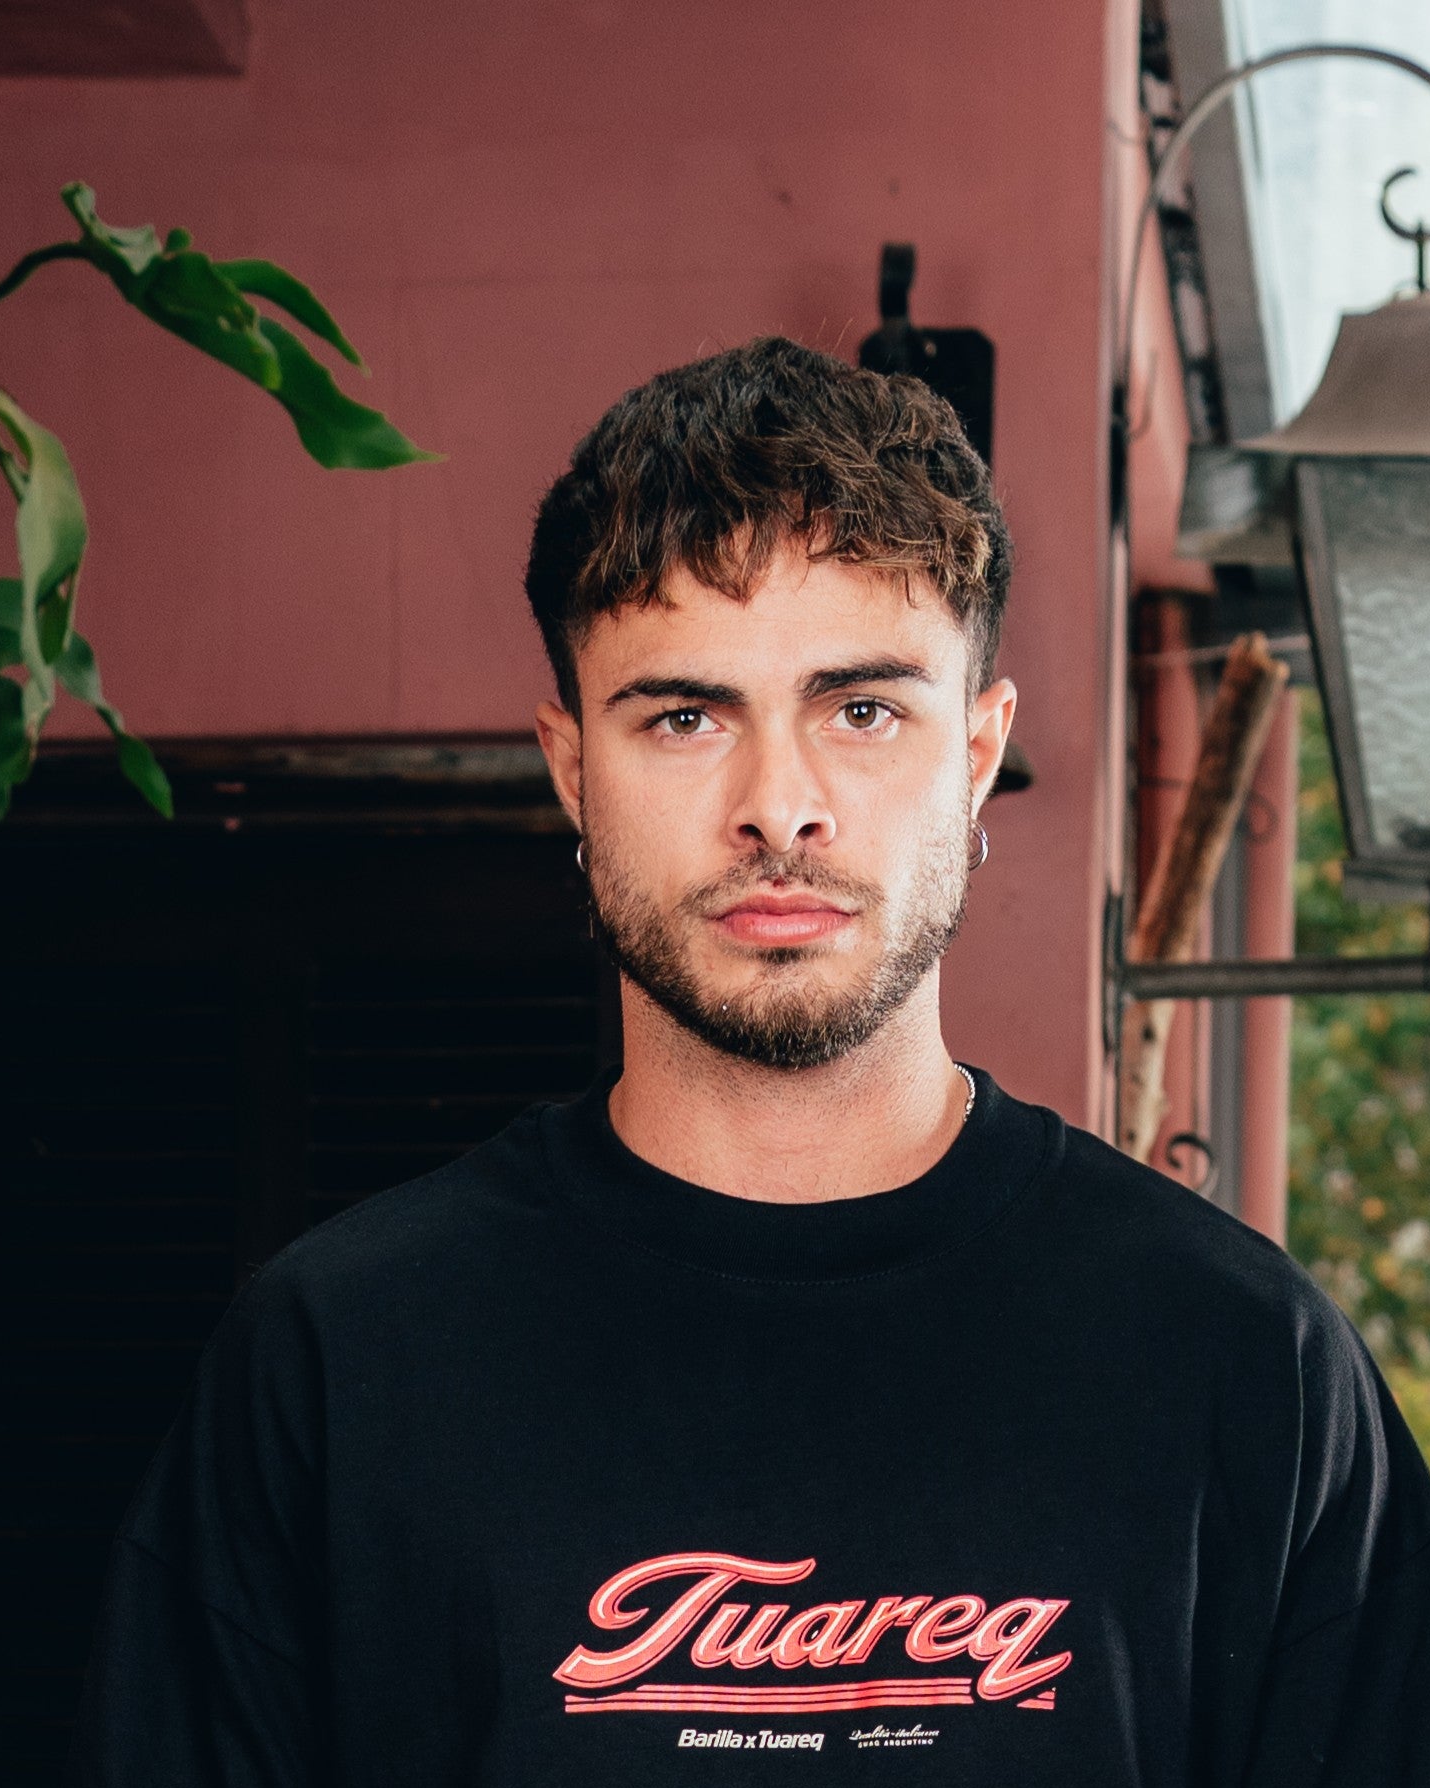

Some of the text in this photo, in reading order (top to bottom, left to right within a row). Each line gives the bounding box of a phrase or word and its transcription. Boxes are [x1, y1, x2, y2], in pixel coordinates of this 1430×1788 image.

[553, 1552, 1072, 1701] Tuareq
[678, 1729, 825, 1752] Barilla x Tuareq
[884, 1738, 934, 1747] ARGENTINO
